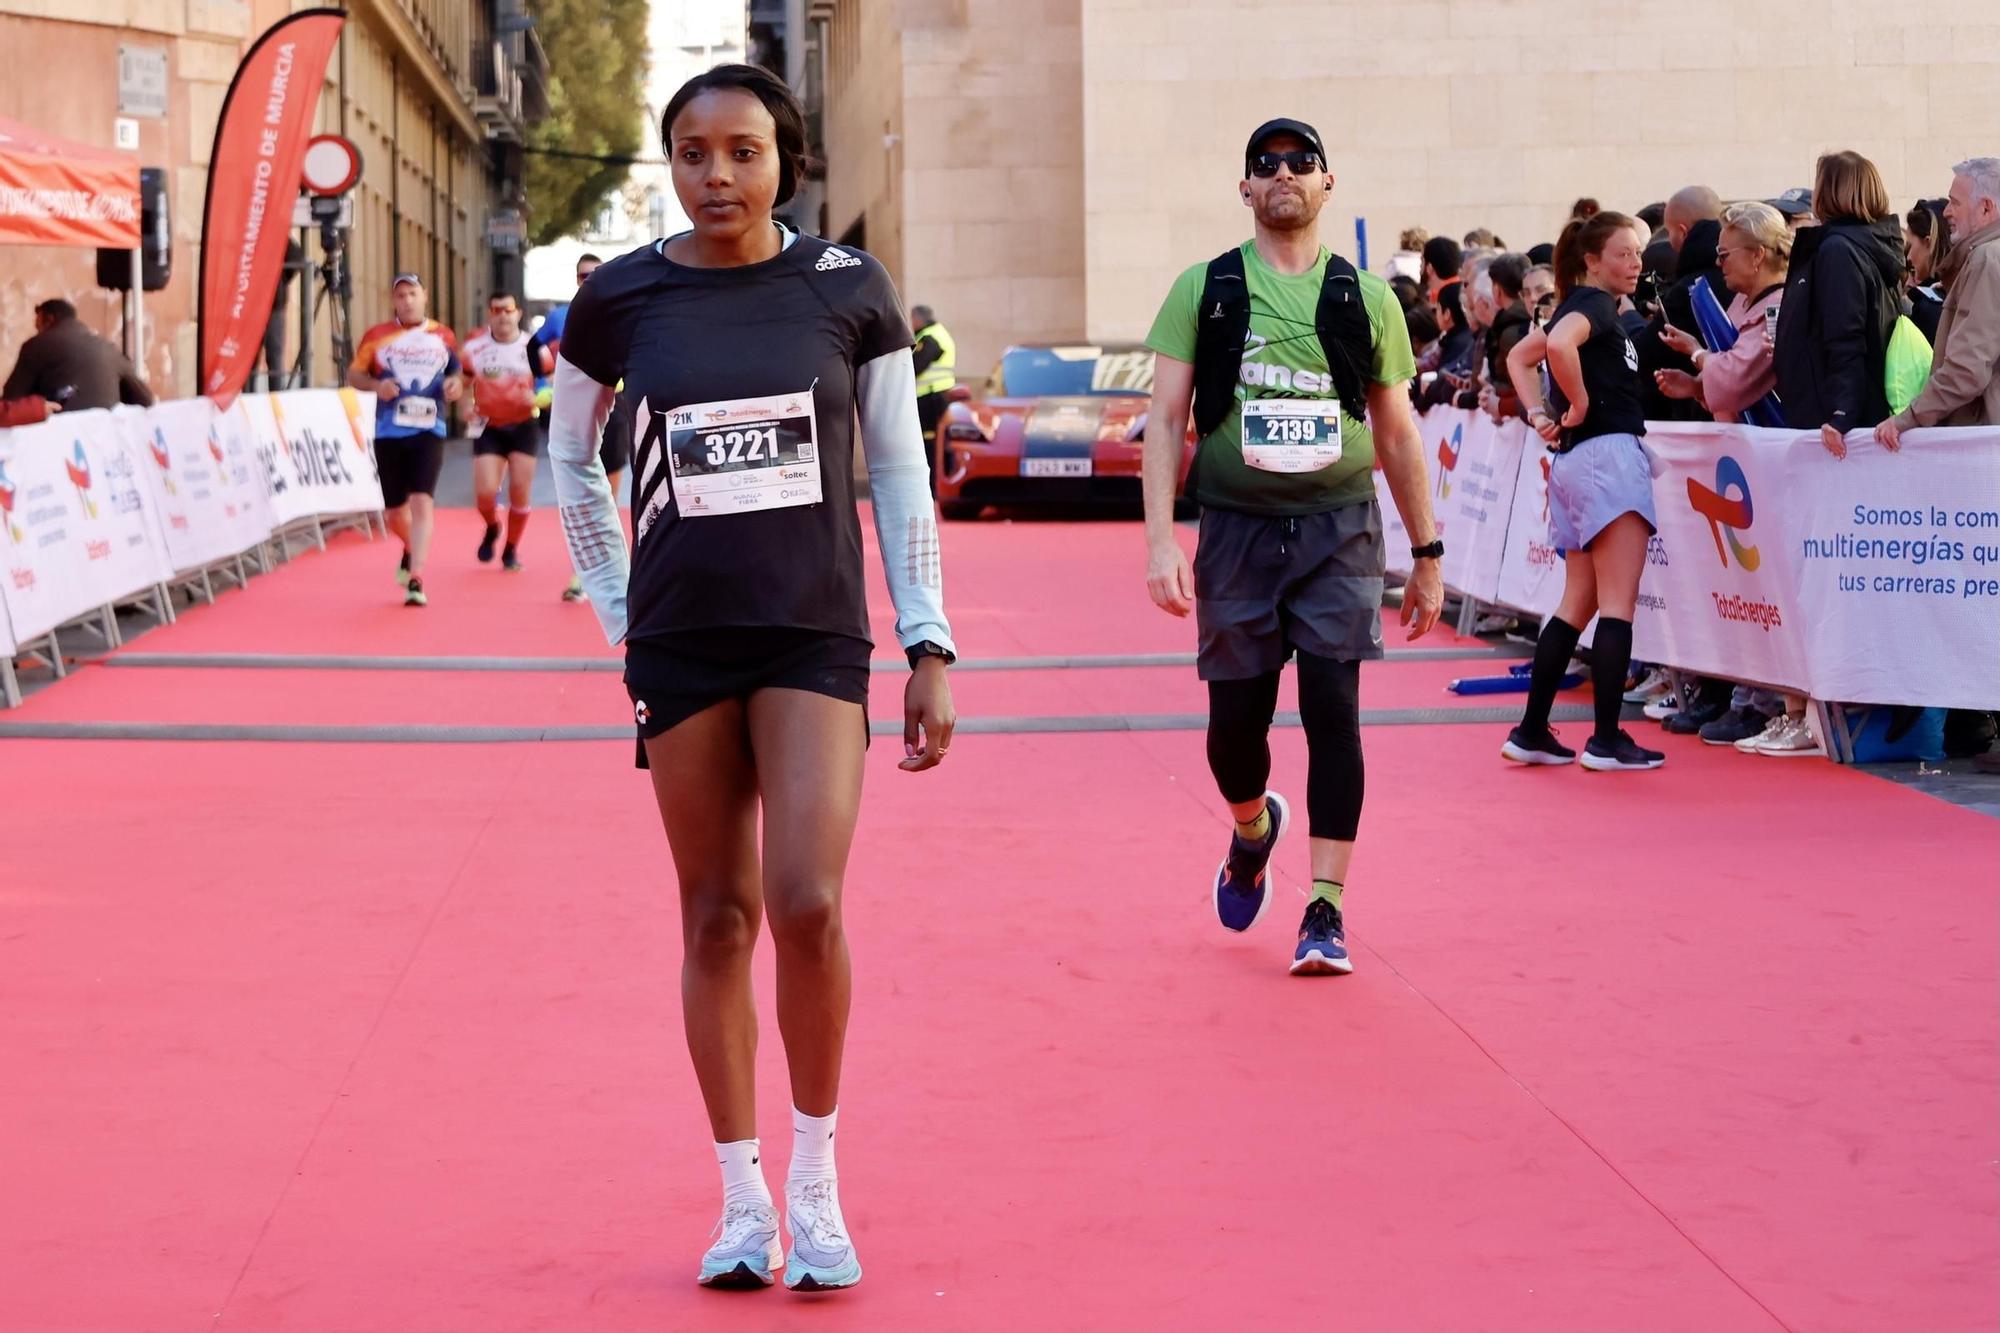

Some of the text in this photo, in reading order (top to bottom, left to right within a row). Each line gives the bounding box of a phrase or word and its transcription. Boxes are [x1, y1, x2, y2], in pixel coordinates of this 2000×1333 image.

[264, 42, 296, 125] MURCIA
[259, 127, 279, 157] DE
[815, 257, 862, 272] adidas
[673, 411, 693, 425] 21K
[1247, 404, 1260, 412] 21K
[1266, 419, 1316, 441] 2139
[705, 427, 779, 466] 3221
[784, 471, 808, 480] soltec
[1853, 504, 1999, 528] Somos la com
[1803, 532, 1999, 566] multienergías qu
[1839, 572, 1999, 599] tus carreras pre
[1711, 592, 1782, 633] TotalEnergies
